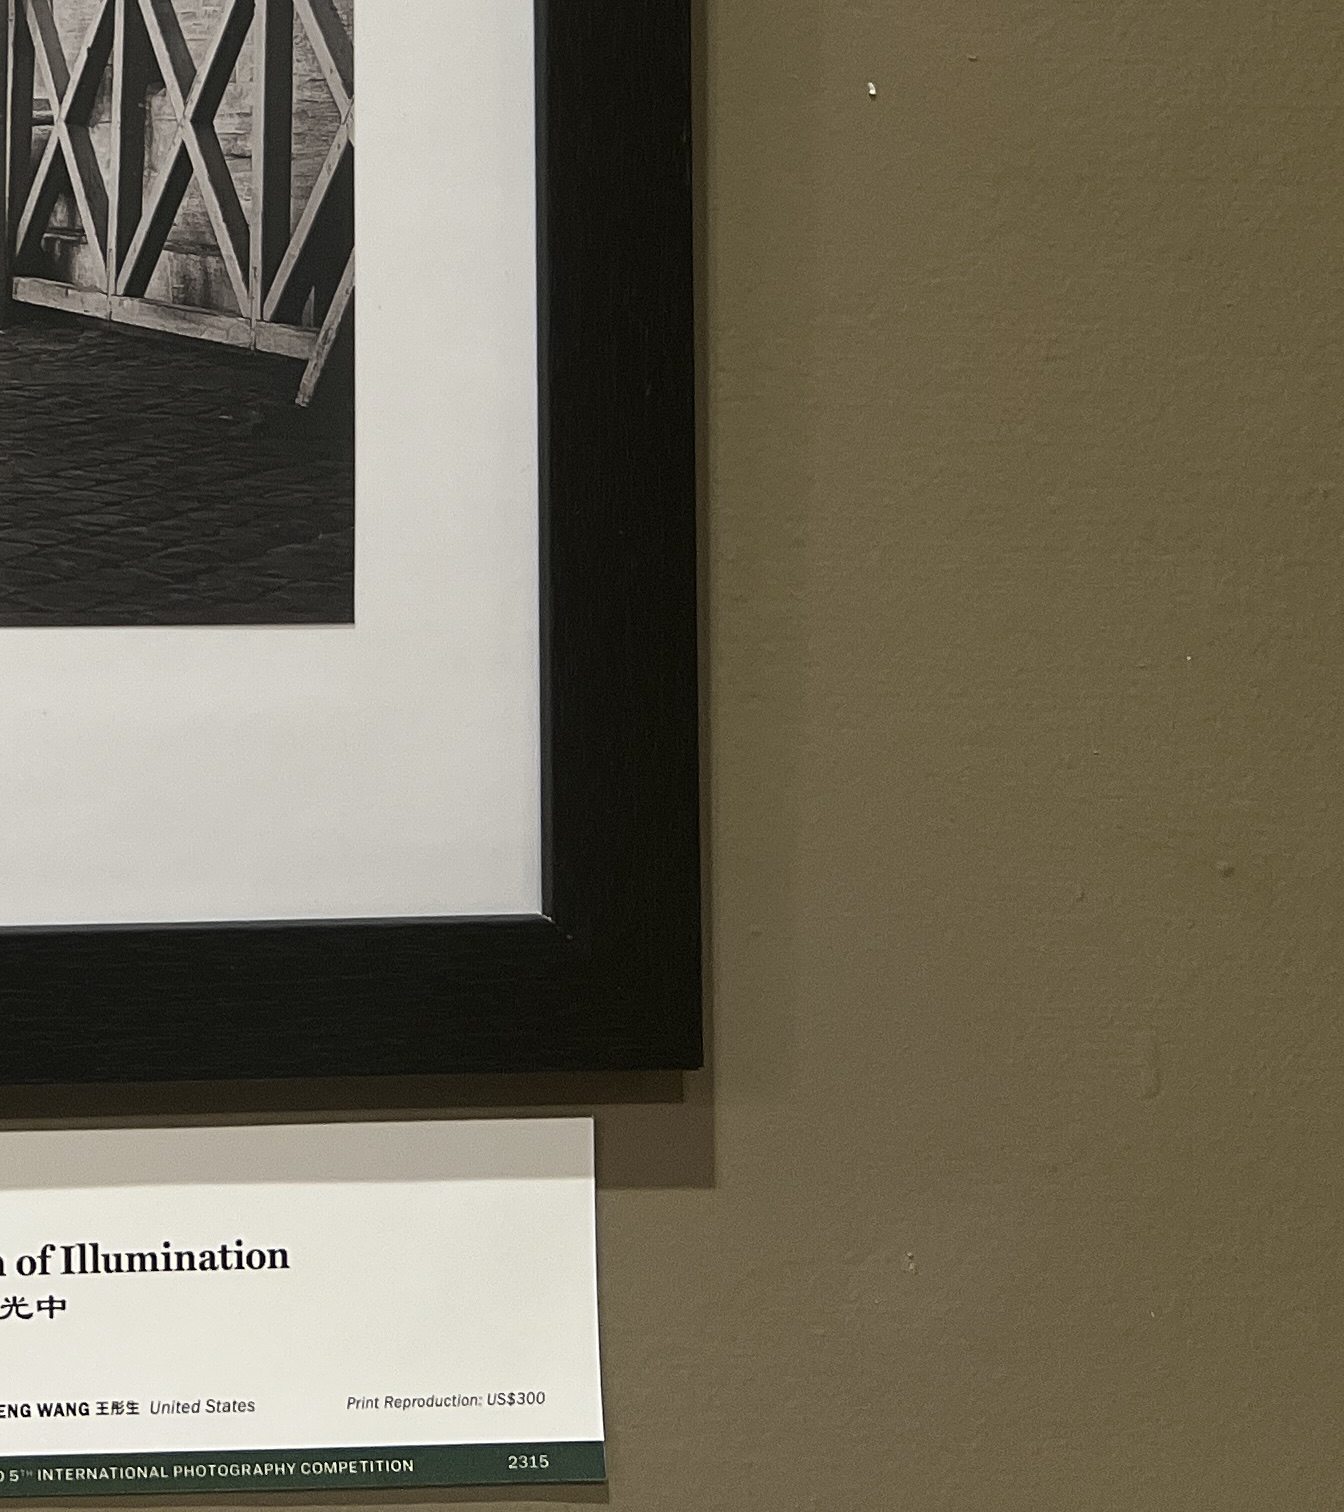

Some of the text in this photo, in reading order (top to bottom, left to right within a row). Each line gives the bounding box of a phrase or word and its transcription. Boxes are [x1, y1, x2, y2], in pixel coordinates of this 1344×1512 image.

[16, 1244, 56, 1276] of
[60, 1239, 291, 1275] Illumination
[36, 1402, 90, 1418] WANG
[150, 1399, 201, 1415] United
[205, 1398, 256, 1414] States
[347, 1391, 546, 1411] Print Reproduction: US$300
[37, 1466, 169, 1481] INTERNATIONAL
[173, 1463, 296, 1478] PHOTOGRAPHY
[300, 1459, 414, 1475] COMPETITION
[508, 1454, 550, 1470] 2315
